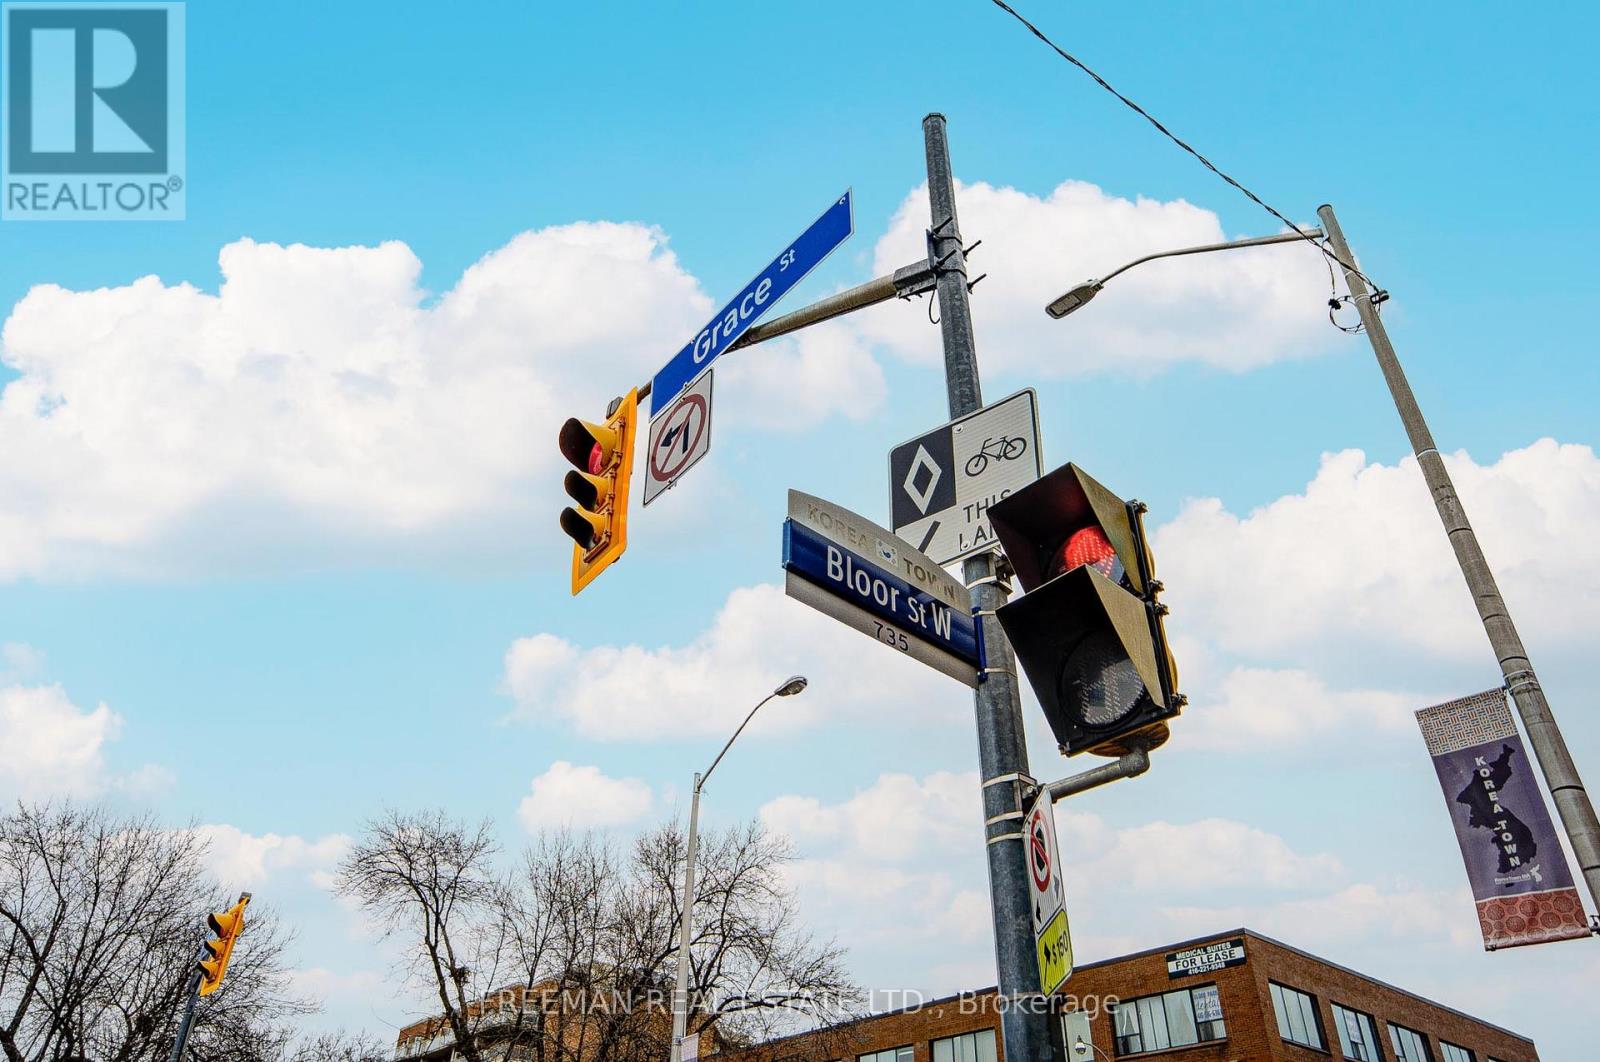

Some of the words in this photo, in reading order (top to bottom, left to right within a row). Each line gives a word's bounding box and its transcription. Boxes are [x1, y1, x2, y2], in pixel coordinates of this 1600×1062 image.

[692, 277, 773, 364] Grace
[779, 248, 796, 273] St
[806, 502, 869, 547] KOREA
[826, 545, 900, 613] Bloor
[907, 595, 928, 629] St
[930, 602, 952, 641] W
[873, 620, 910, 652] 735
[1474, 755, 1503, 814] KOREA
[1498, 819, 1522, 868] TOWN
[1175, 948, 1206, 960] MEDICAL
[1206, 941, 1232, 953] SUITES
[1175, 958, 1197, 971] FOR
[1200, 949, 1236, 964] LEASE
